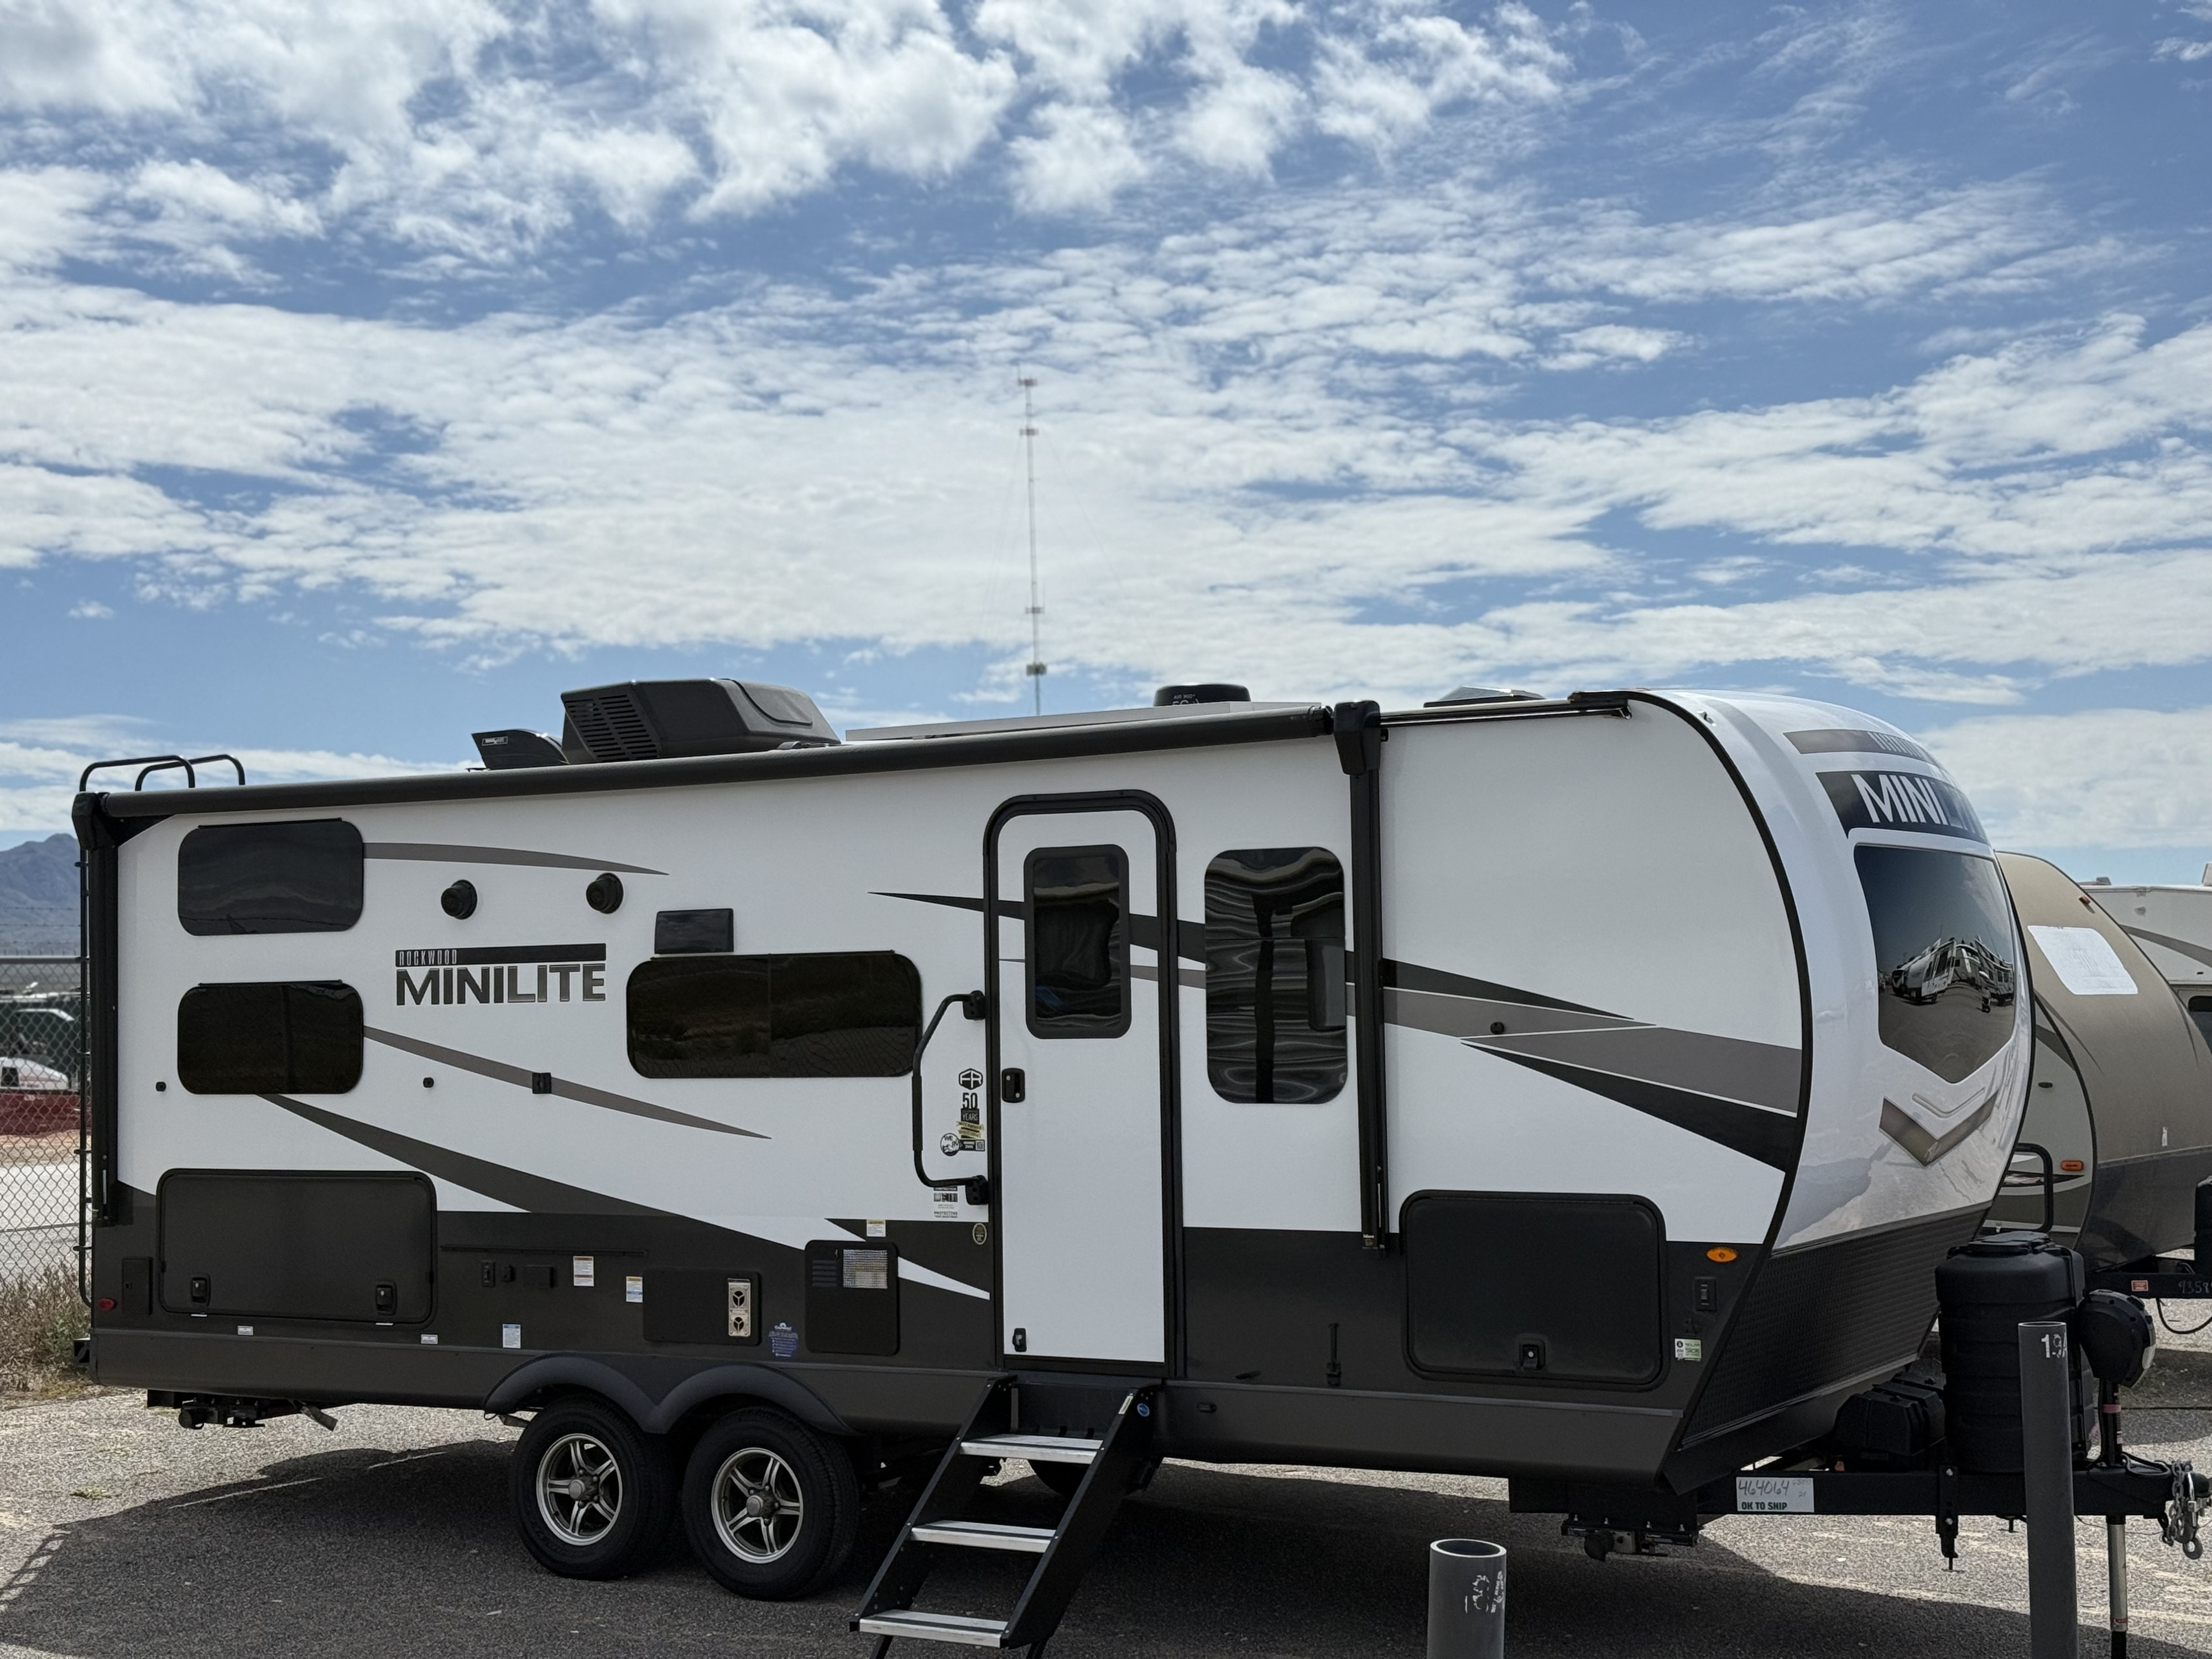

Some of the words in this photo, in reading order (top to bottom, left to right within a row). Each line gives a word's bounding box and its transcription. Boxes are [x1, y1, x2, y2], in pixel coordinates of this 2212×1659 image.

[399, 950, 457, 966] ROCKWOOD
[397, 963, 606, 1005] MINILITE
[962, 1092, 978, 1109] 50
[962, 1113, 978, 1121] YEARS
[1738, 1480, 1790, 1496] 464064
[1741, 1501, 1754, 1510] OK
[1755, 1501, 1766, 1510] TO
[1767, 1501, 1787, 1510] SHIP
